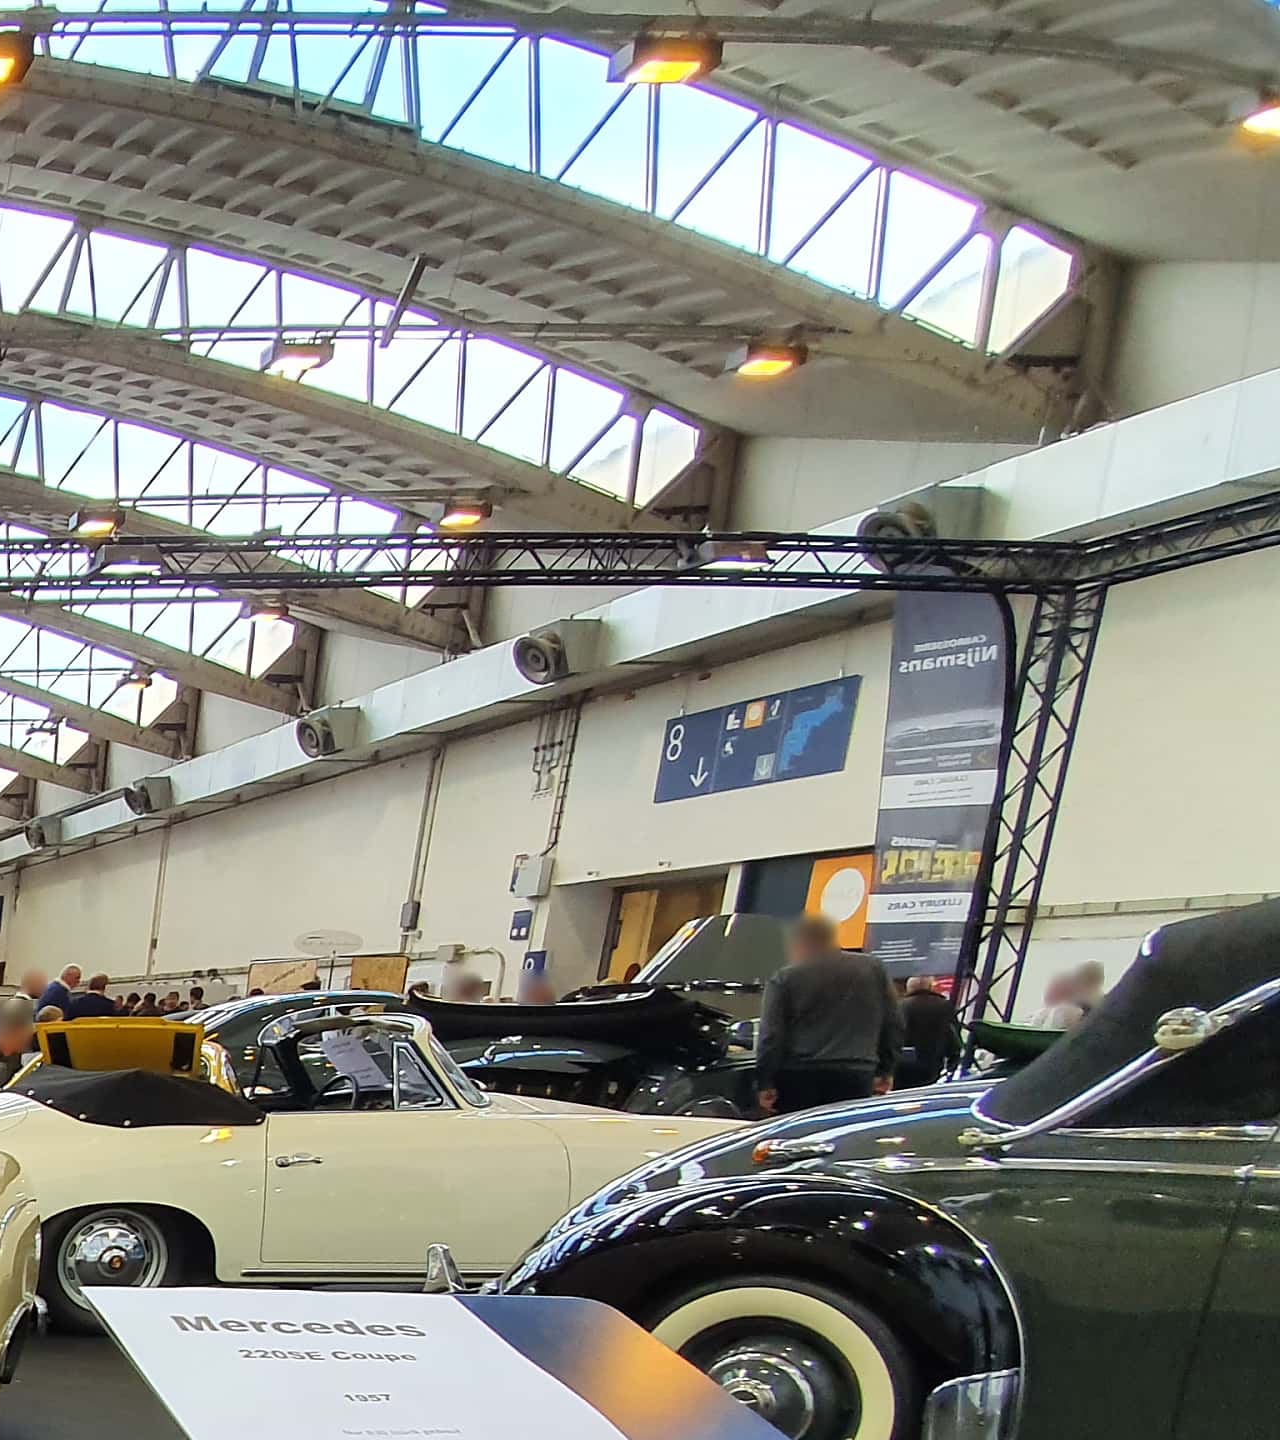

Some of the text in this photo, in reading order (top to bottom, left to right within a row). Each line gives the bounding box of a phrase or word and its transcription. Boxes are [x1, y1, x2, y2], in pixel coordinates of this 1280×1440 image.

[666, 724, 685, 761] 8
[169, 1314, 428, 1338] Mercedes
[238, 1349, 326, 1361] 220SE
[343, 1393, 392, 1403] 1957
